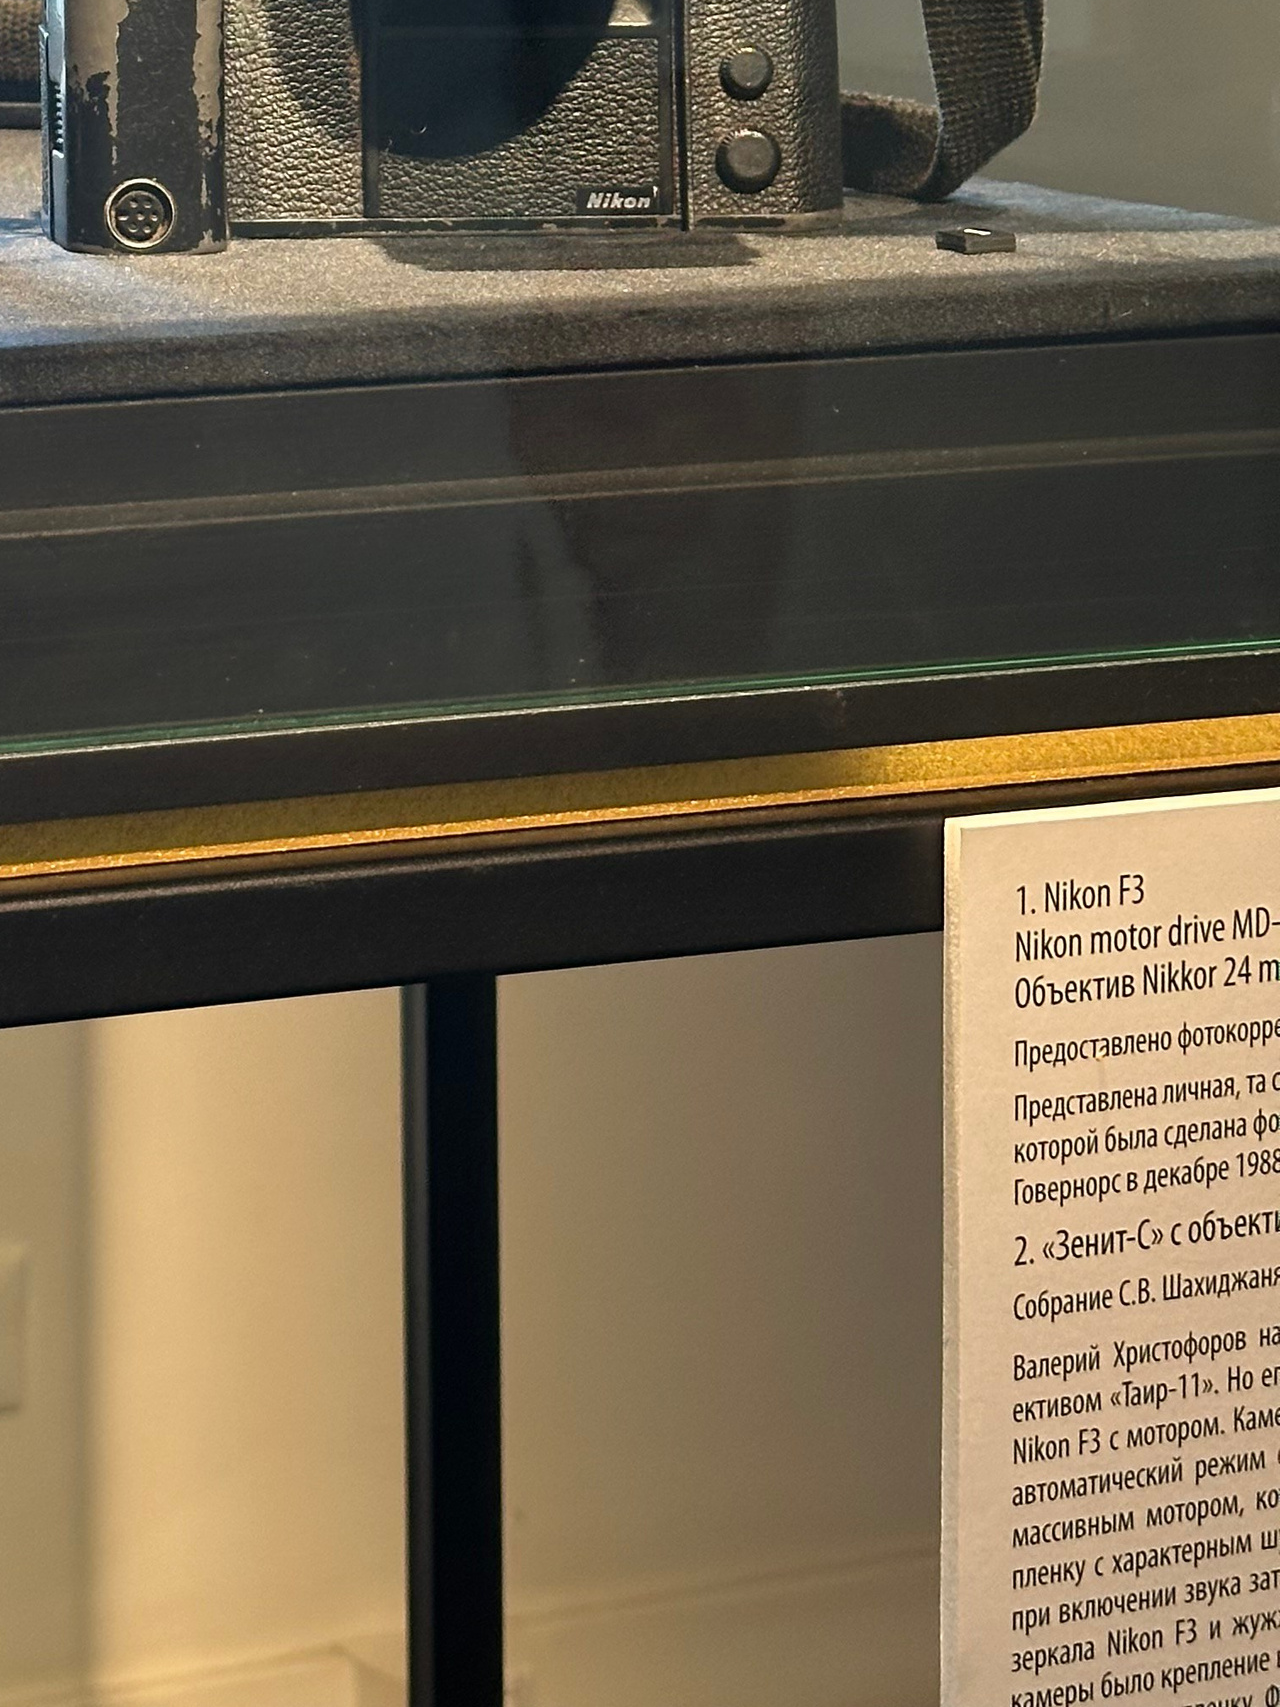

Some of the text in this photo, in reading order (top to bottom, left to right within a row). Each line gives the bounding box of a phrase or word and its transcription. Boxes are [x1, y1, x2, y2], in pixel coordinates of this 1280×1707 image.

[586, 192, 652, 209] Nikon
[1016, 873, 1145, 916] 1. Nikon F3
[1015, 906, 1280, 963] Nikon motor drive MD-
[1014, 974, 1136, 1009] Объектив
[1142, 959, 1219, 996] Nikkor
[1222, 954, 1253, 987] 24
[1014, 1030, 1173, 1074] Предоставлено
[1014, 1085, 1158, 1128] Представлена
[1161, 1076, 1241, 1106] личная,
[1244, 1073, 1267, 1097] та
[1013, 1107, 1280, 1167] которой была сделана фо
[1014, 1147, 1280, 1208] Говернорс в декабре 1988
[1013, 1235, 1035, 1267] 2.
[1042, 1218, 1164, 1262] «Зенит-С»
[1013, 1288, 1114, 1324] Собрание
[1118, 1277, 1157, 1307] С.В.
[1013, 1325, 1280, 1385] Валерий Христофоров на
[1012, 1391, 1103, 1425] ективом
[1109, 1371, 1220, 1414] «Таир-11».
[1227, 1364, 1255, 1394] Но
[1013, 1433, 1071, 1466] Nikon
[1078, 1427, 1101, 1457] F3
[1126, 1415, 1227, 1450] мотором.
[1011, 1449, 1267, 1508] автоматический режим
[1012, 1488, 1280, 1549] массивным мотором, ко
[1012, 1558, 1087, 1591] пленку
[1111, 1533, 1253, 1581] характерным
[1012, 1568, 1280, 1641] при включении звука зат
[1010, 1640, 1096, 1678] зеркала
[1107, 1625, 1164, 1659] Nikon
[1175, 1617, 1198, 1648] F3
[1209, 1619, 1223, 1641] и
[1100, 1670, 1156, 1701] было
[1160, 1651, 1272, 1695] крепление
